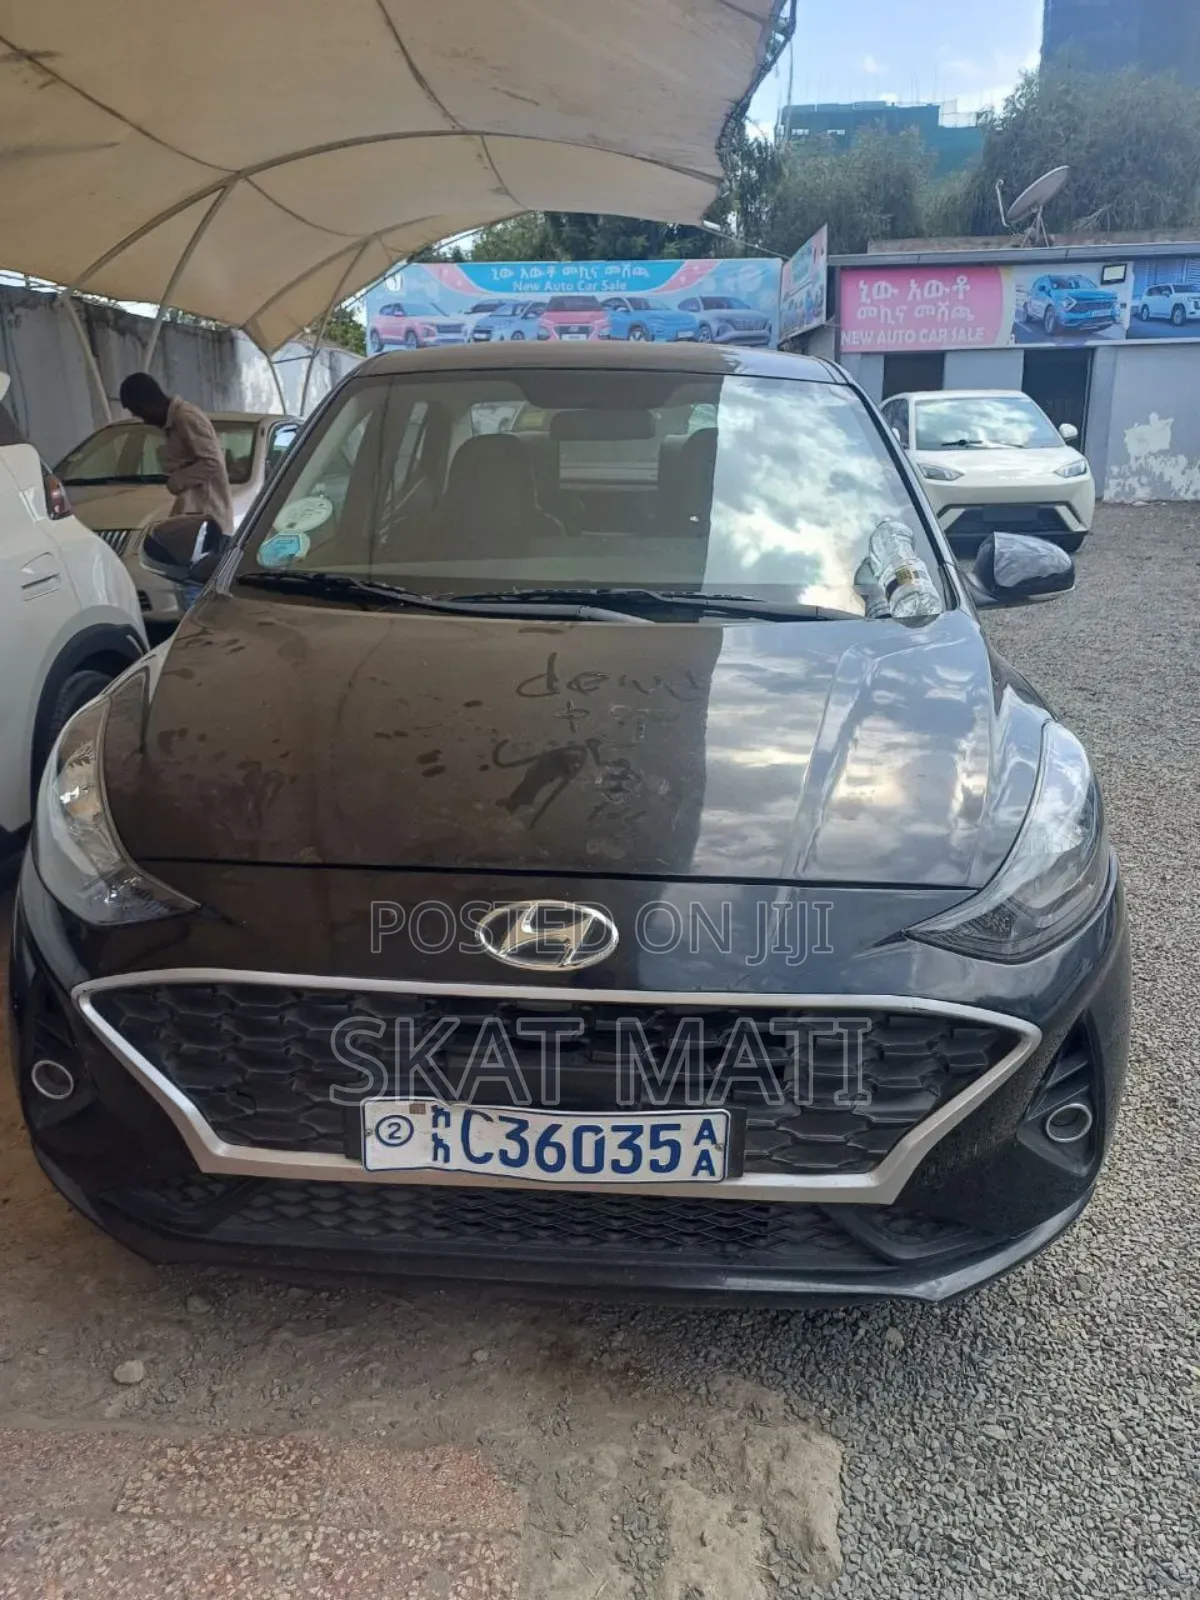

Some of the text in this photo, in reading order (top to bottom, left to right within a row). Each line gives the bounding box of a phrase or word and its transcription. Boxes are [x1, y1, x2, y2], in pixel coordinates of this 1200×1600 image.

[512, 280, 627, 291] New Auto Car Sale
[840, 326, 985, 346] NEW AUTO CAR SALE
[388, 1121, 402, 1140] 2
[461, 1108, 682, 1175] C36035
